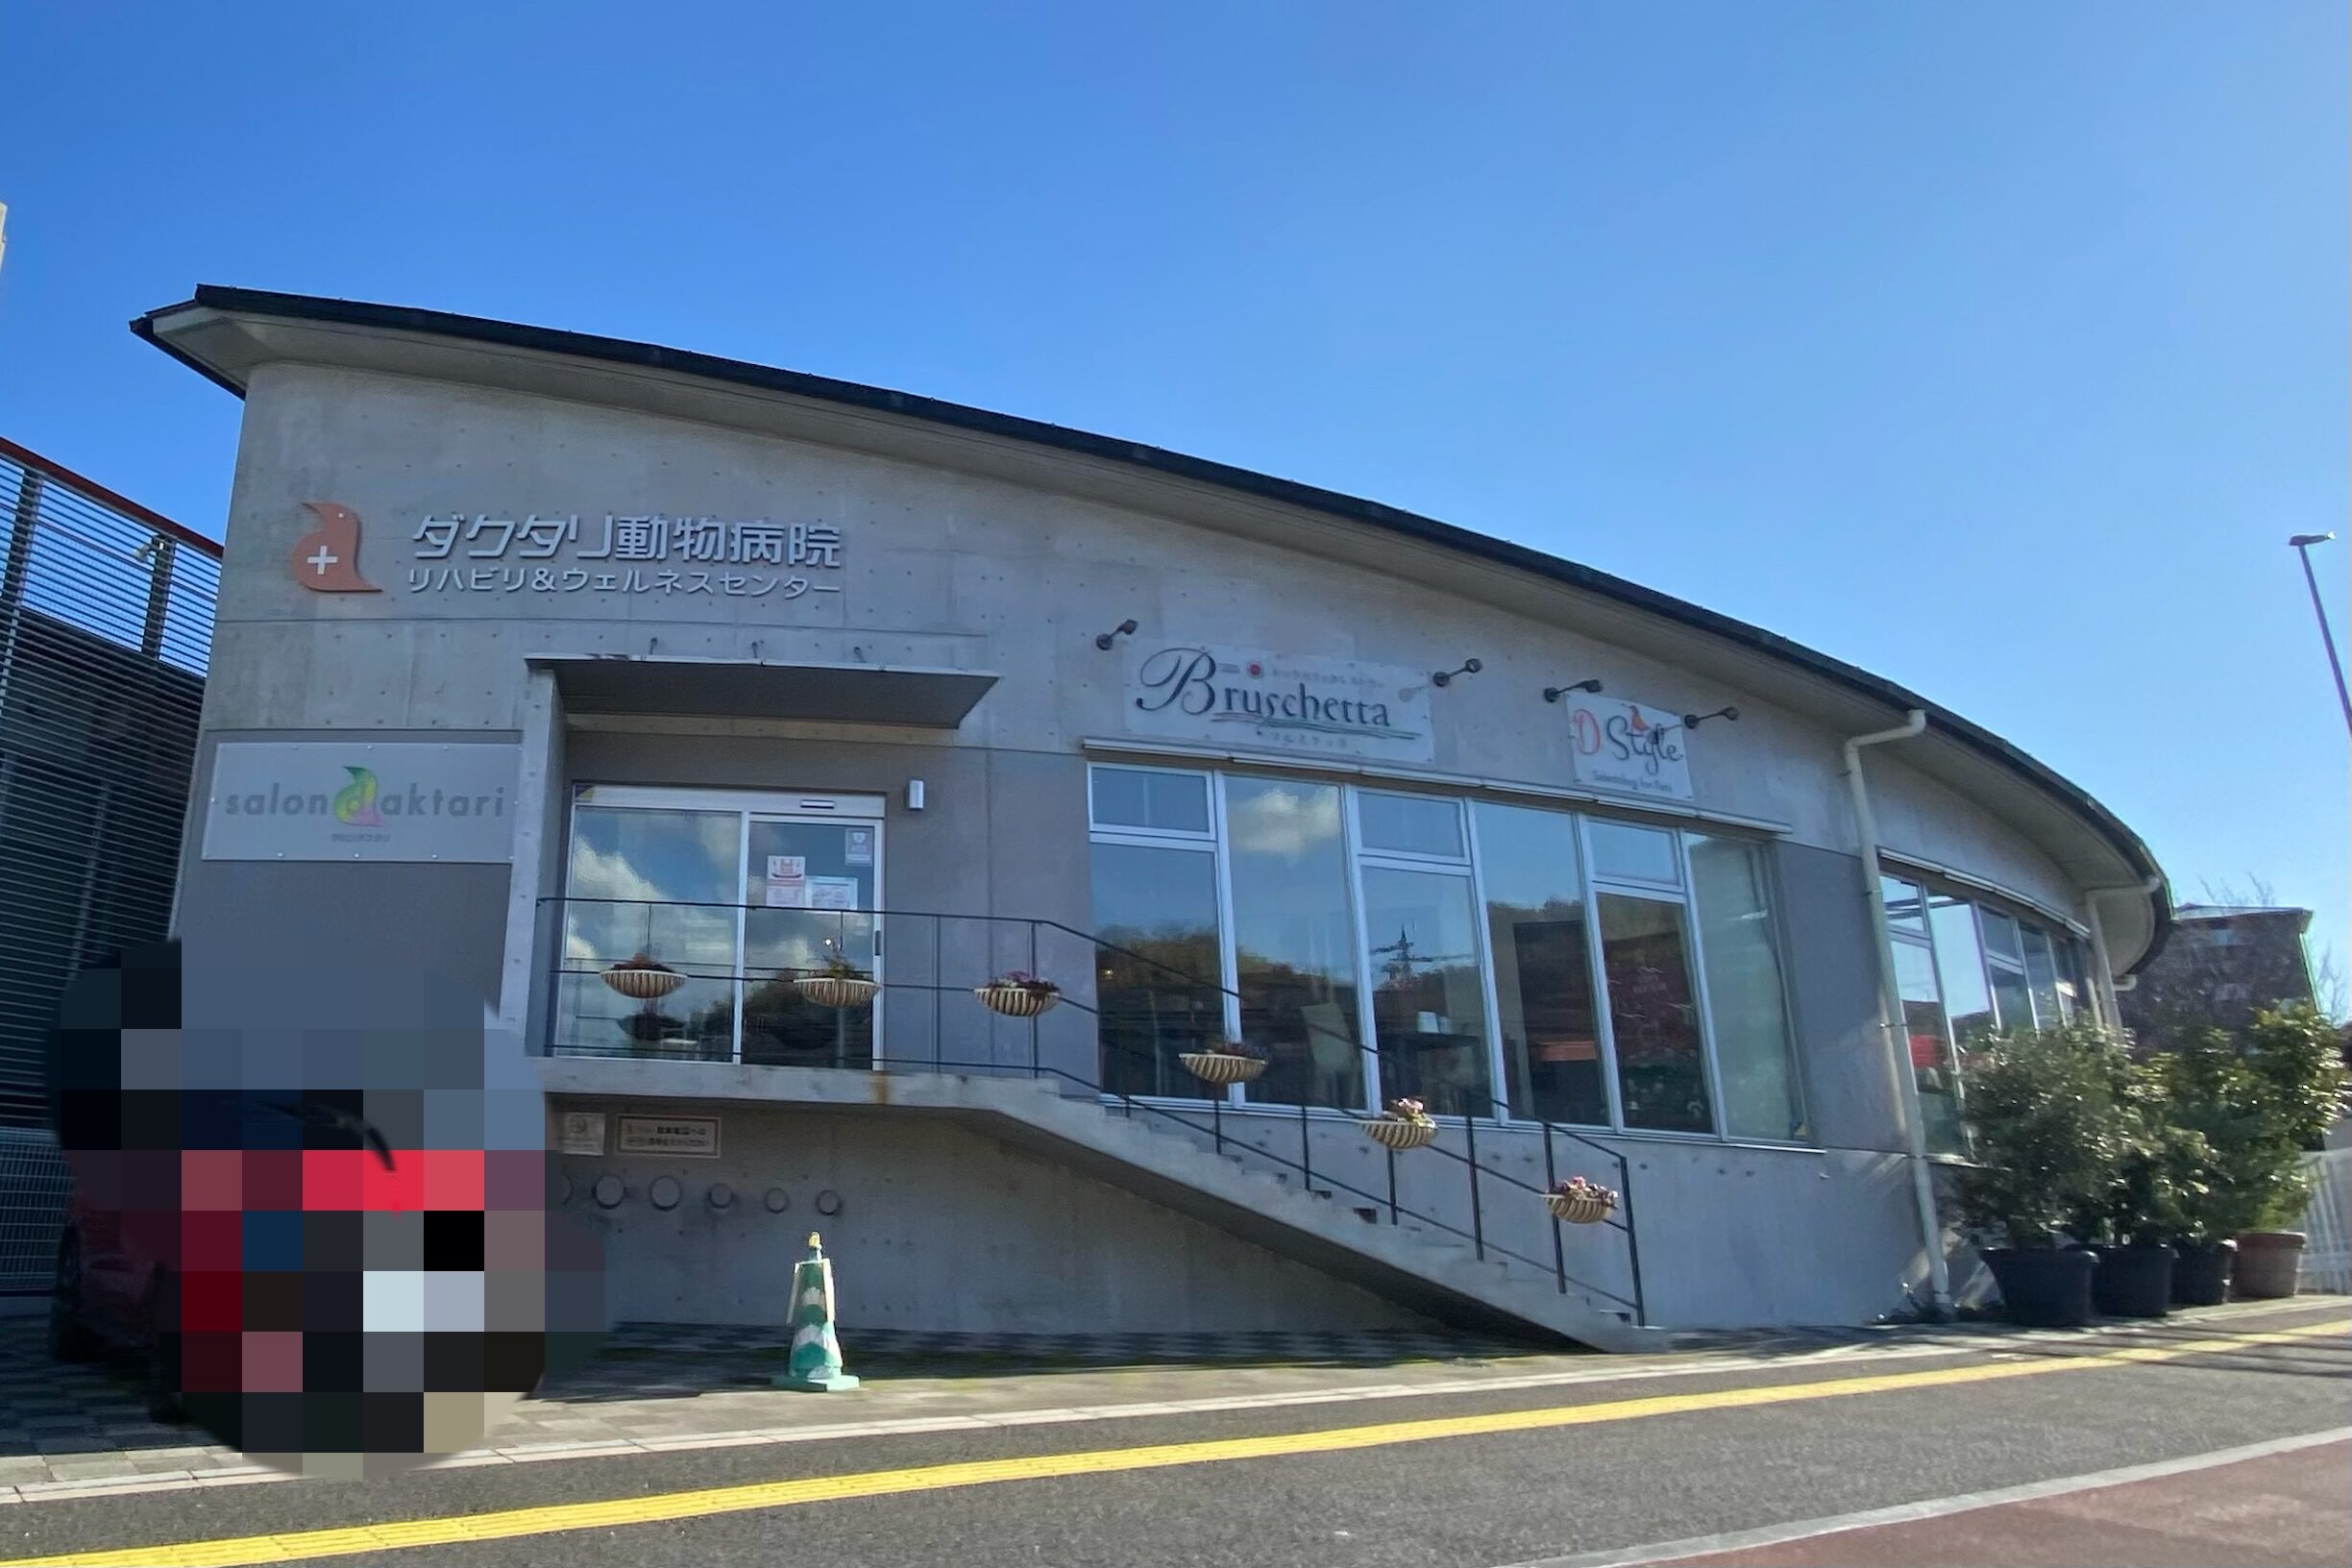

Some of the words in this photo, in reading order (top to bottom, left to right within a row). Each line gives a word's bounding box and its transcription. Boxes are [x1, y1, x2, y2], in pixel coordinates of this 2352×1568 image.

[412, 514, 841, 568] ダクタリ動物病院
[408, 567, 841, 600] リハビリ&ウェルネスセンター
[1136, 647, 1391, 727] Bruschetta
[1573, 708, 1602, 755] D
[1605, 715, 1684, 776] Style
[225, 782, 329, 817] salon
